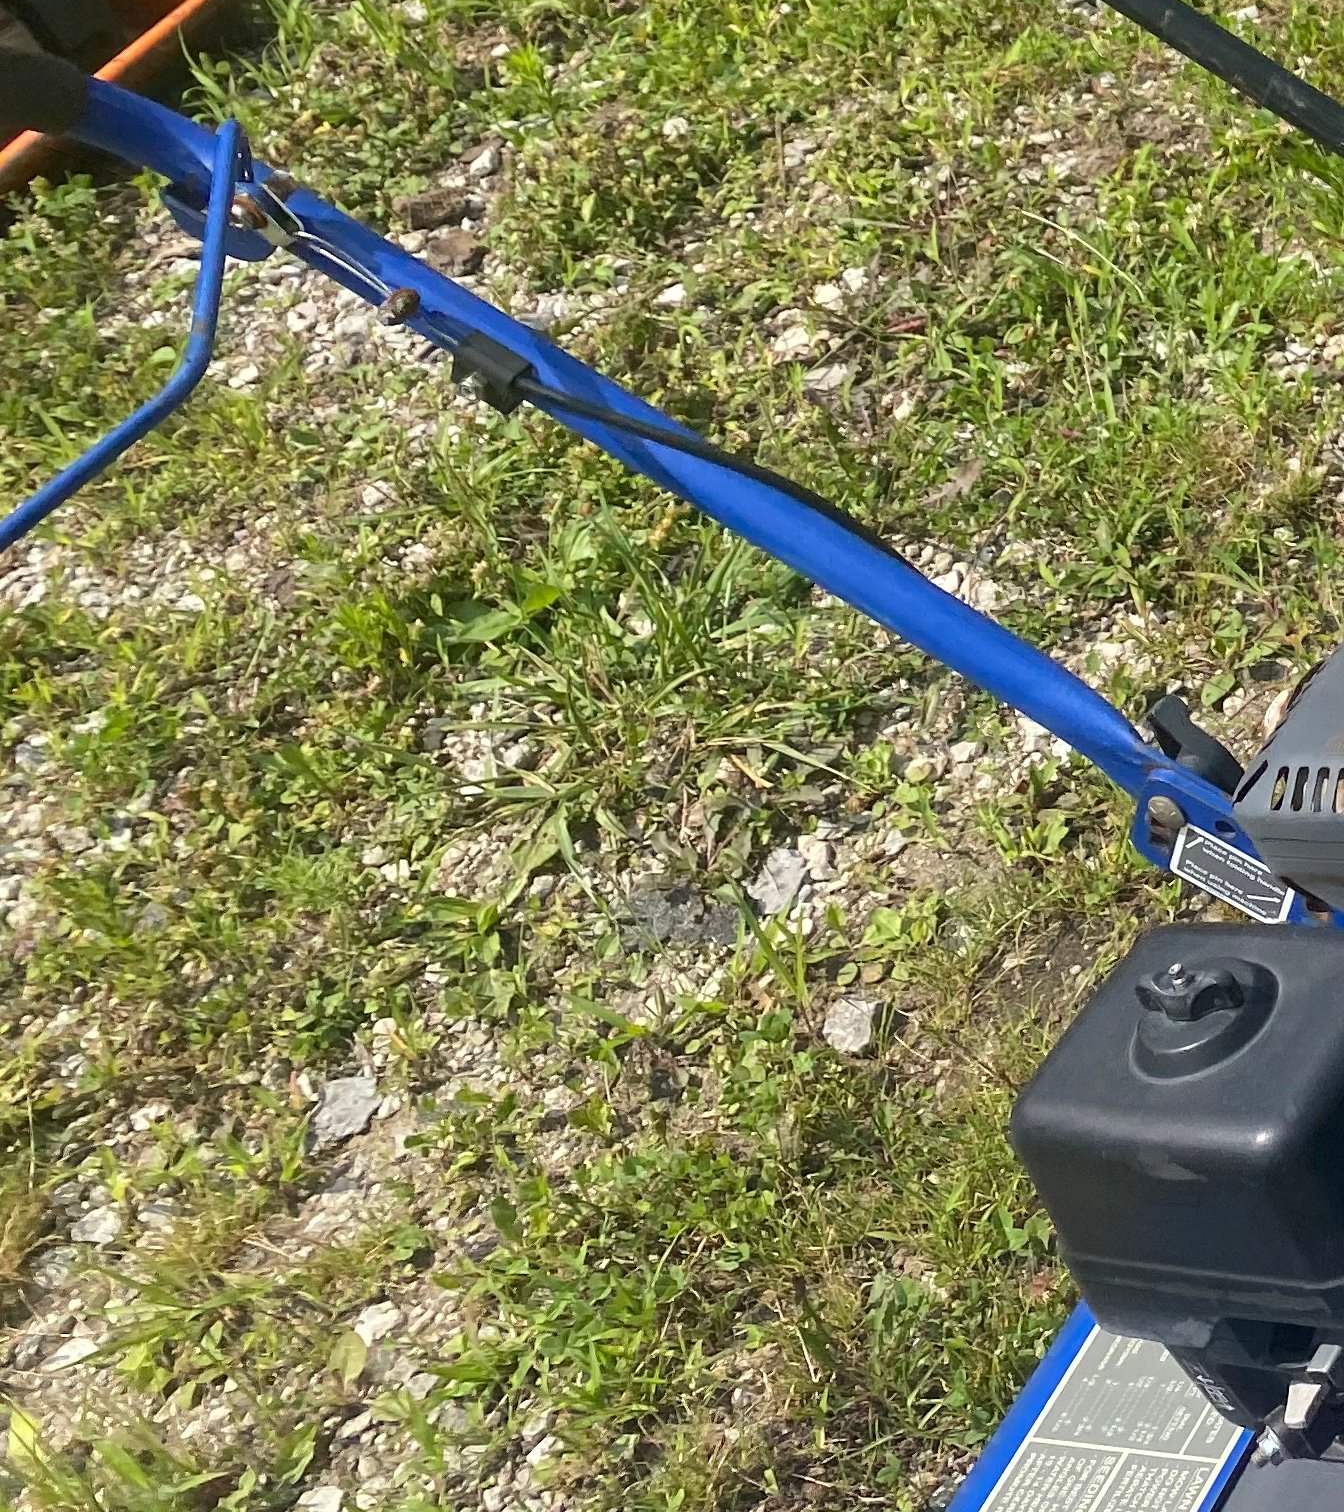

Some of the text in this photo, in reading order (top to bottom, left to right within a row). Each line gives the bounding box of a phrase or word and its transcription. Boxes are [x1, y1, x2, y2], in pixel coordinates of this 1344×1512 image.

[1201, 846, 1225, 862] when
[1225, 860, 1256, 879] folding
[1203, 839, 1263, 876] Place pin here
[1182, 866, 1267, 916] when using machine
[1184, 859, 1244, 895] Place pin here
[1177, 1465, 1209, 1512] LAWN
